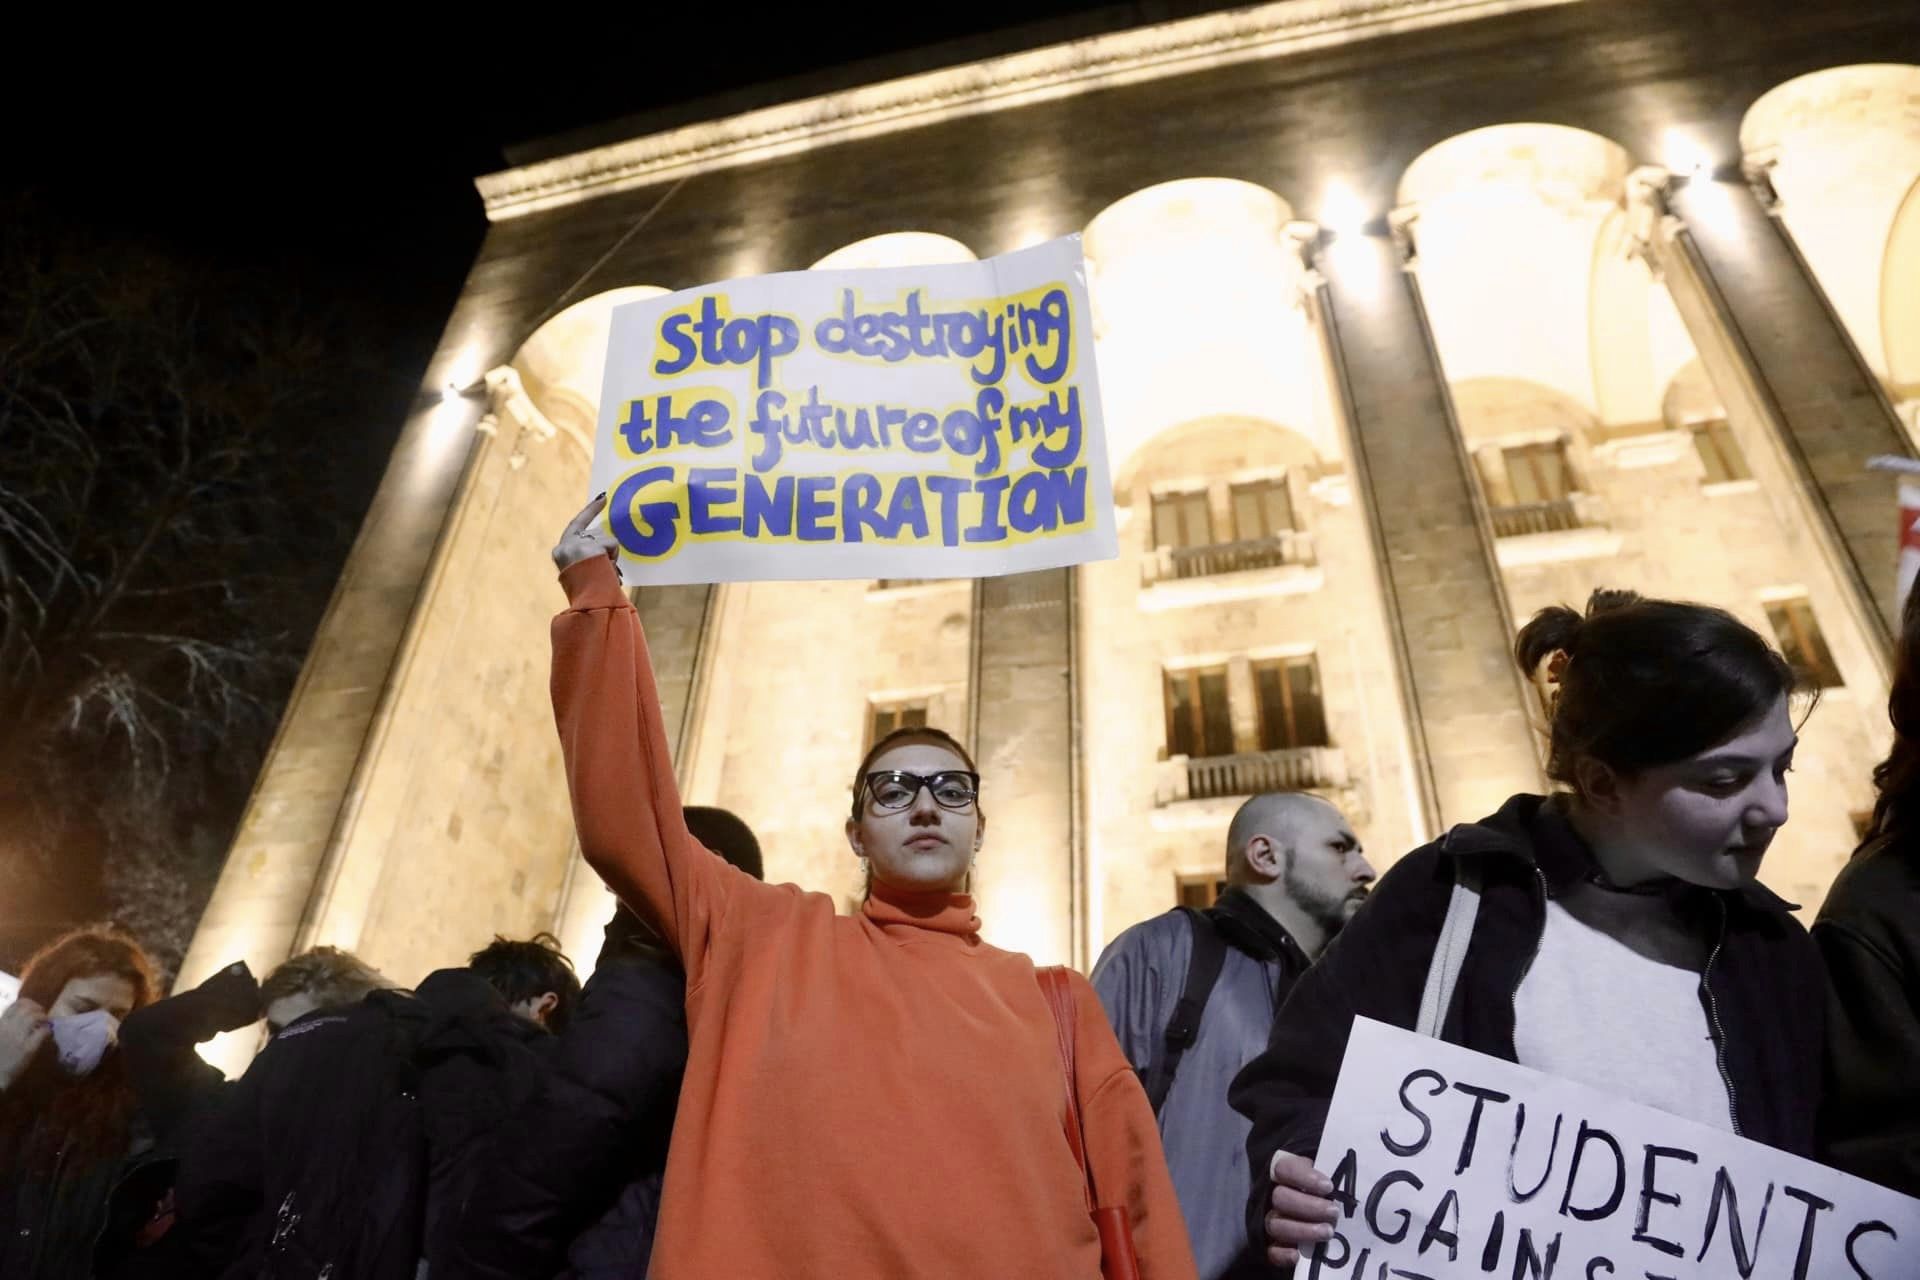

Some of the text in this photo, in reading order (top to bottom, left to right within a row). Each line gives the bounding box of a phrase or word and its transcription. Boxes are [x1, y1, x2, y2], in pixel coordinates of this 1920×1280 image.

[655, 289, 1070, 388] stop destroying
[620, 386, 1082, 475] the future of my
[609, 466, 1088, 557] GENERATION
[1380, 1069, 1897, 1280] STUDENTS
